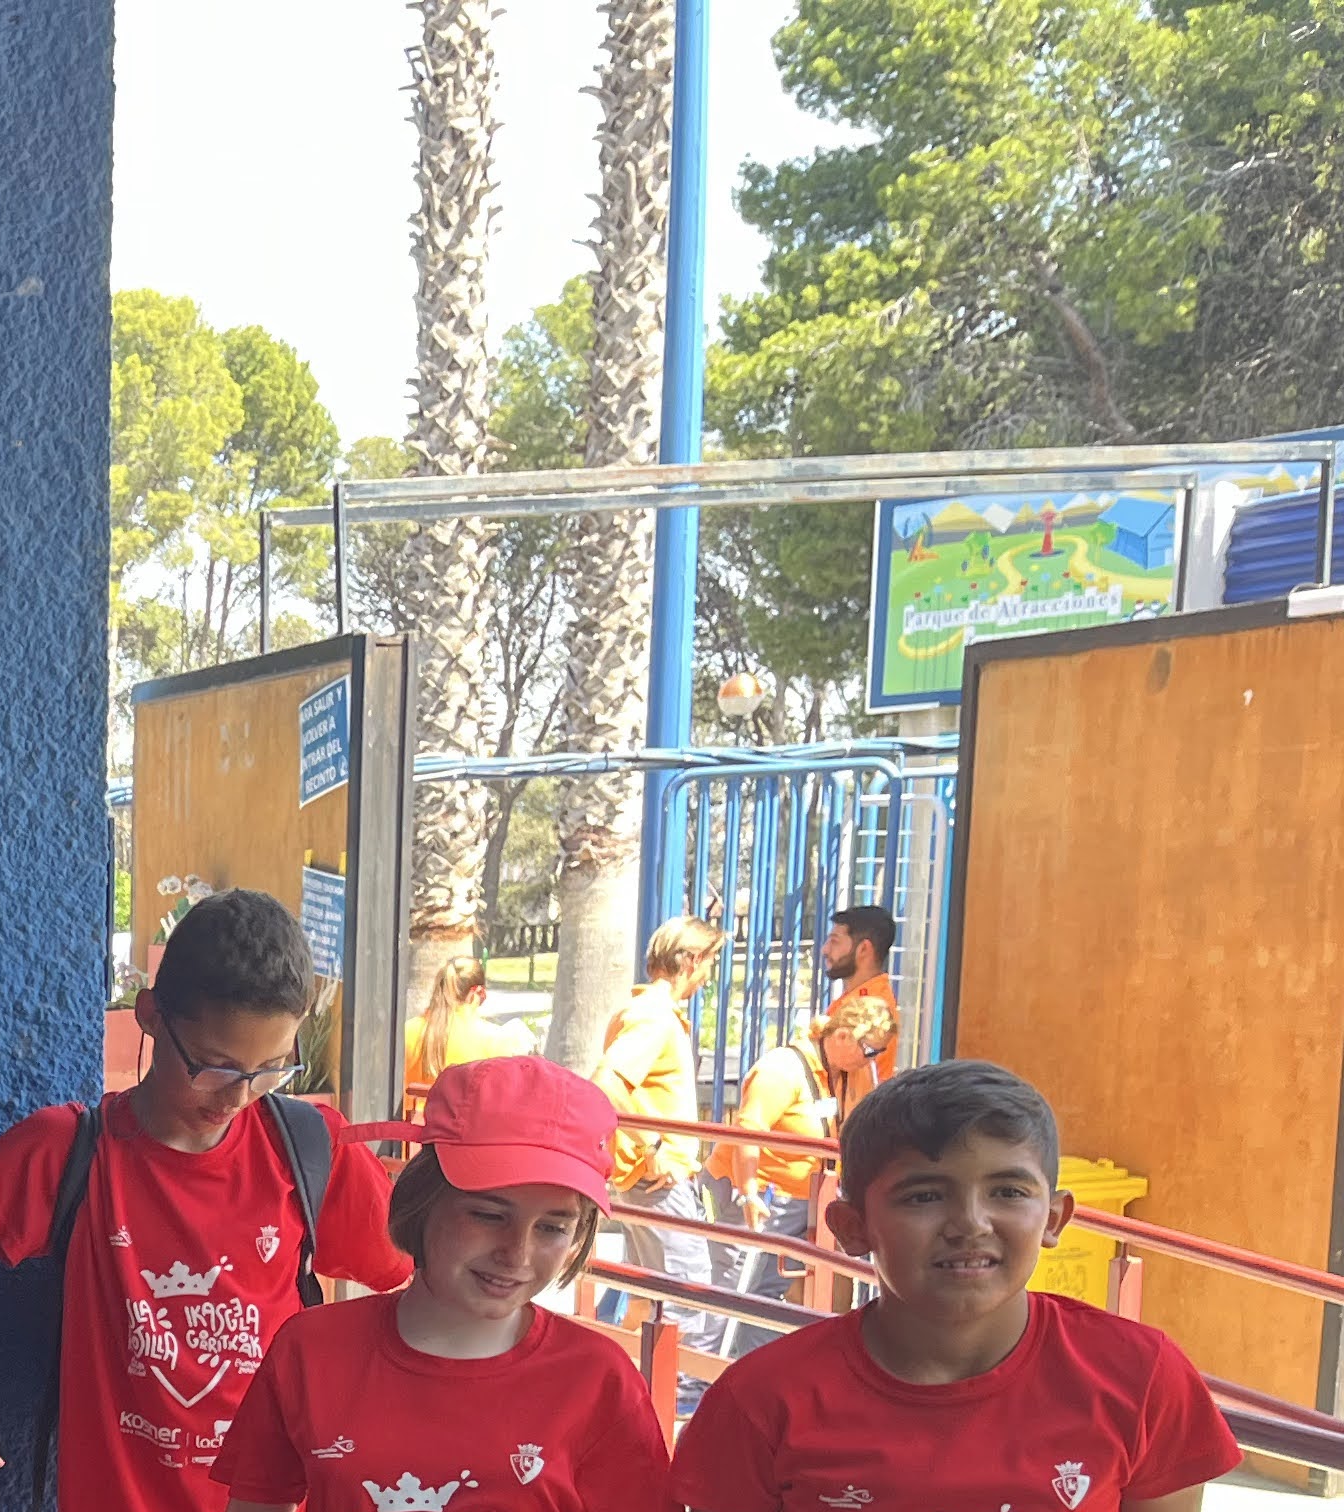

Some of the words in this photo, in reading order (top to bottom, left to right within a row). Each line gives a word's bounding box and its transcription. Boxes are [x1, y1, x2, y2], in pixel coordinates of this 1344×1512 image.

[905, 609, 962, 630] Parque
[968, 603, 990, 621] de
[998, 593, 1119, 620] Atracciones
[336, 685, 343, 701] Y
[328, 715, 336, 730] A
